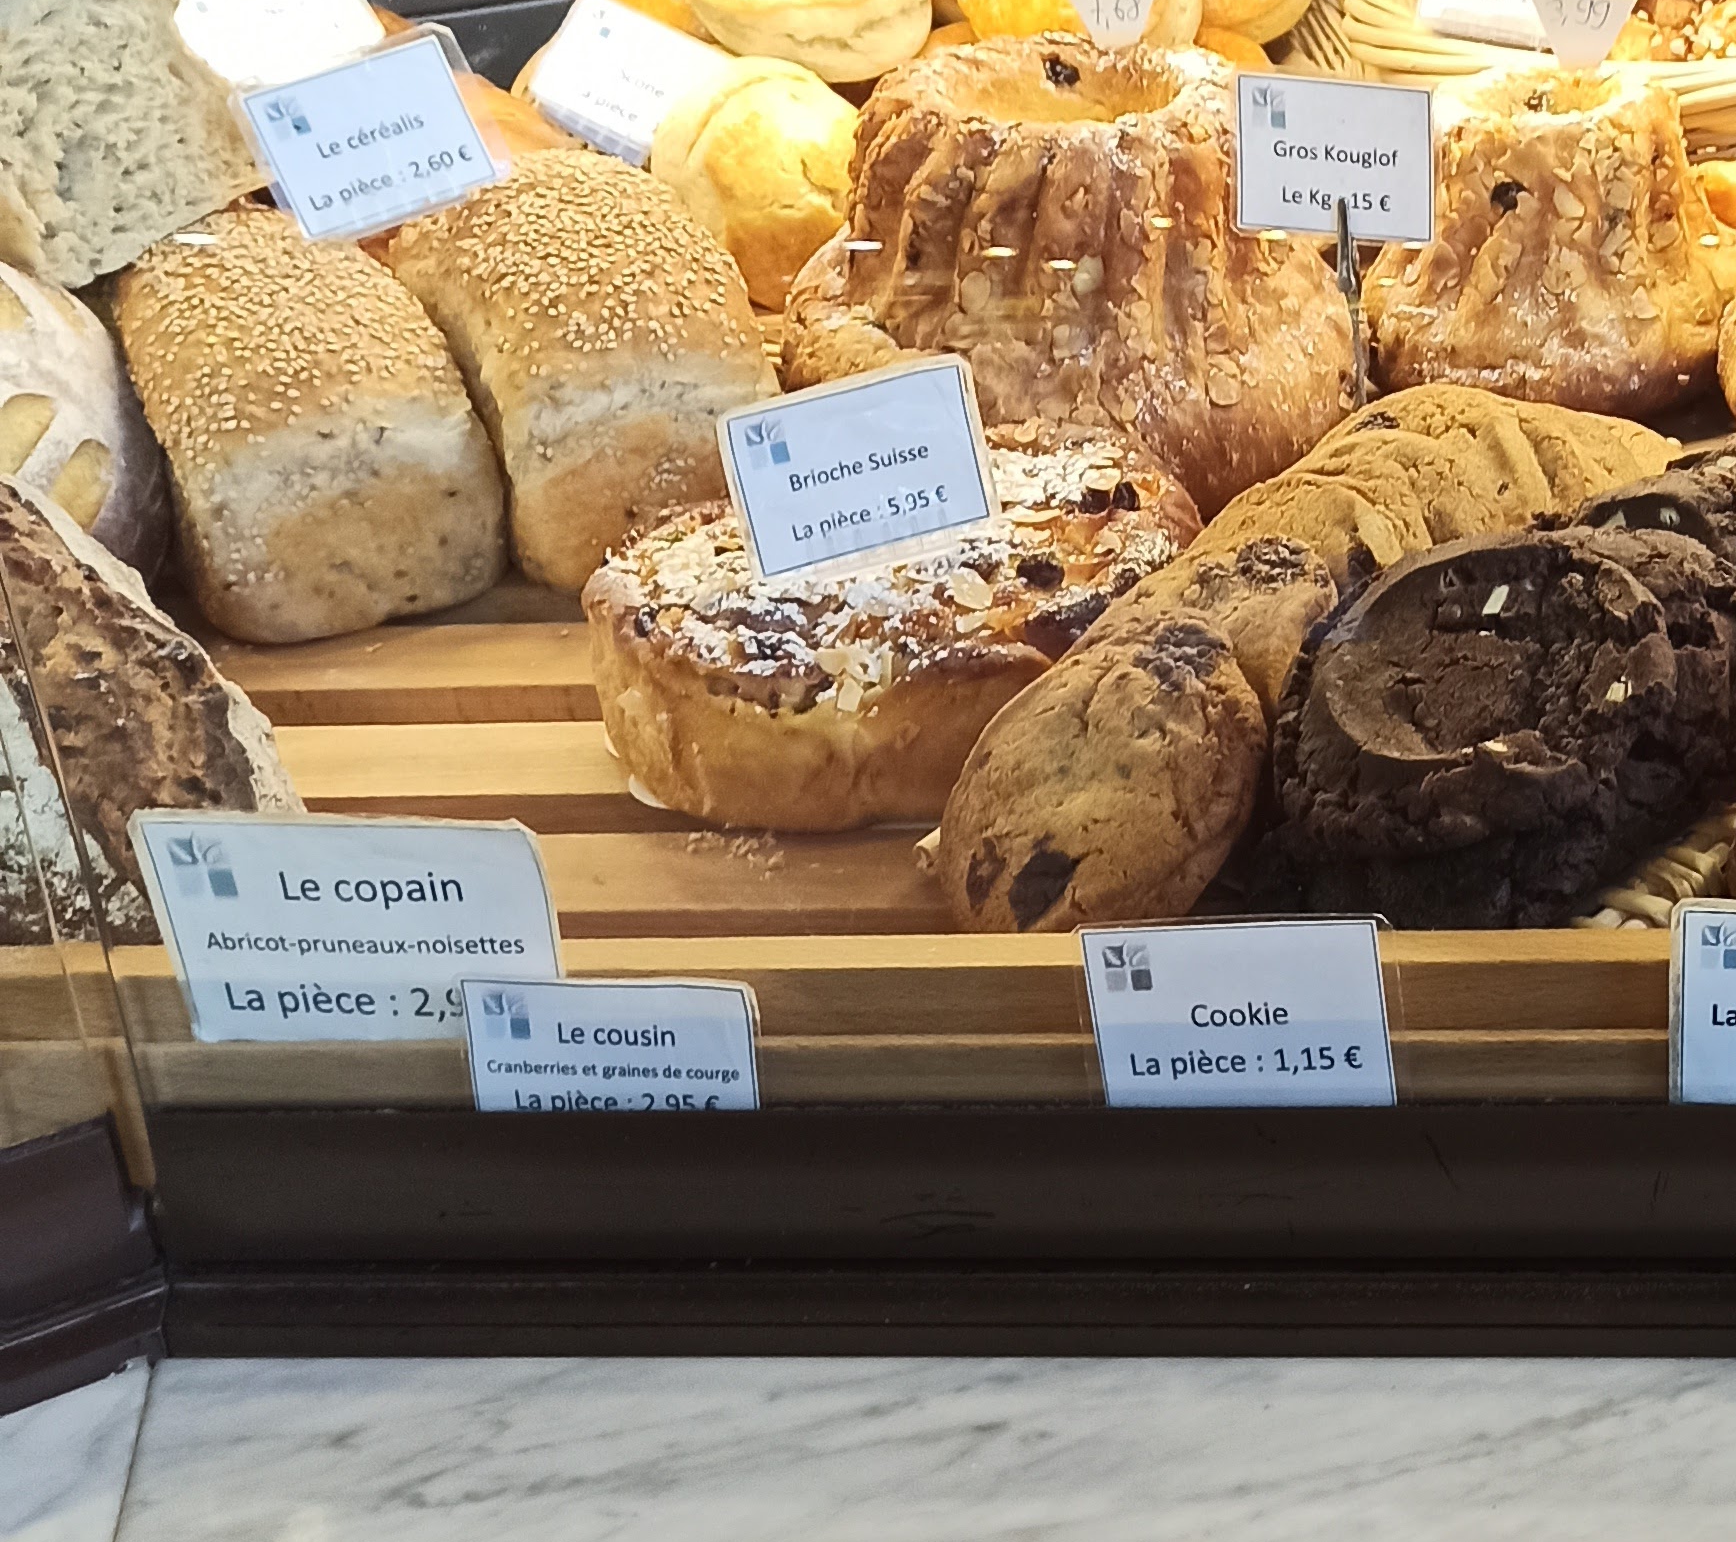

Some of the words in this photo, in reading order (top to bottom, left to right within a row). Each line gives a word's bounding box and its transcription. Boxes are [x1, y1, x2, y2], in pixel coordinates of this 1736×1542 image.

[315, 139, 342, 160] Le
[347, 111, 425, 150] céréalis
[1273, 140, 1319, 161] Gros
[1324, 144, 1398, 169] Kouglof
[308, 192, 333, 212] La
[338, 172, 394, 204] pièce
[408, 150, 455, 181] 2,60
[458, 143, 473, 162] €
[1282, 185, 1303, 205] Le
[1310, 188, 1332, 211] Kg
[1351, 192, 1372, 210] 15
[1380, 194, 1391, 212] €
[788, 459, 864, 493] Brioche
[868, 444, 930, 473] Suisse
[791, 523, 814, 542] La
[819, 508, 872, 538] pièce
[887, 488, 931, 519] 5,95
[934, 484, 949, 503] €
[278, 871, 321, 902] Le
[334, 871, 464, 910] copain
[206, 931, 525, 957] Abricot-pruneaux-noisettes
[224, 981, 265, 1013] La
[277, 982, 377, 1019] pièce
[390, 993, 398, 1016] :
[1190, 1001, 1289, 1027] Cookie
[557, 1022, 585, 1045] Le
[593, 1024, 676, 1047] cousin
[486, 1059, 578, 1076] Cranberries
[582, 1062, 597, 1076] et
[602, 1062, 659, 1080] graines
[662, 1064, 682, 1079] de
[686, 1067, 740, 1084] courge
[1130, 1053, 1161, 1076] La
[1171, 1048, 1247, 1080] pièce
[1274, 1046, 1336, 1075] 1,15
[1344, 1045, 1363, 1069] €
[514, 1089, 541, 1109] La
[550, 1089, 618, 1109] pièce
[641, 1093, 695, 1109] 295
[704, 1095, 720, 1109] €
